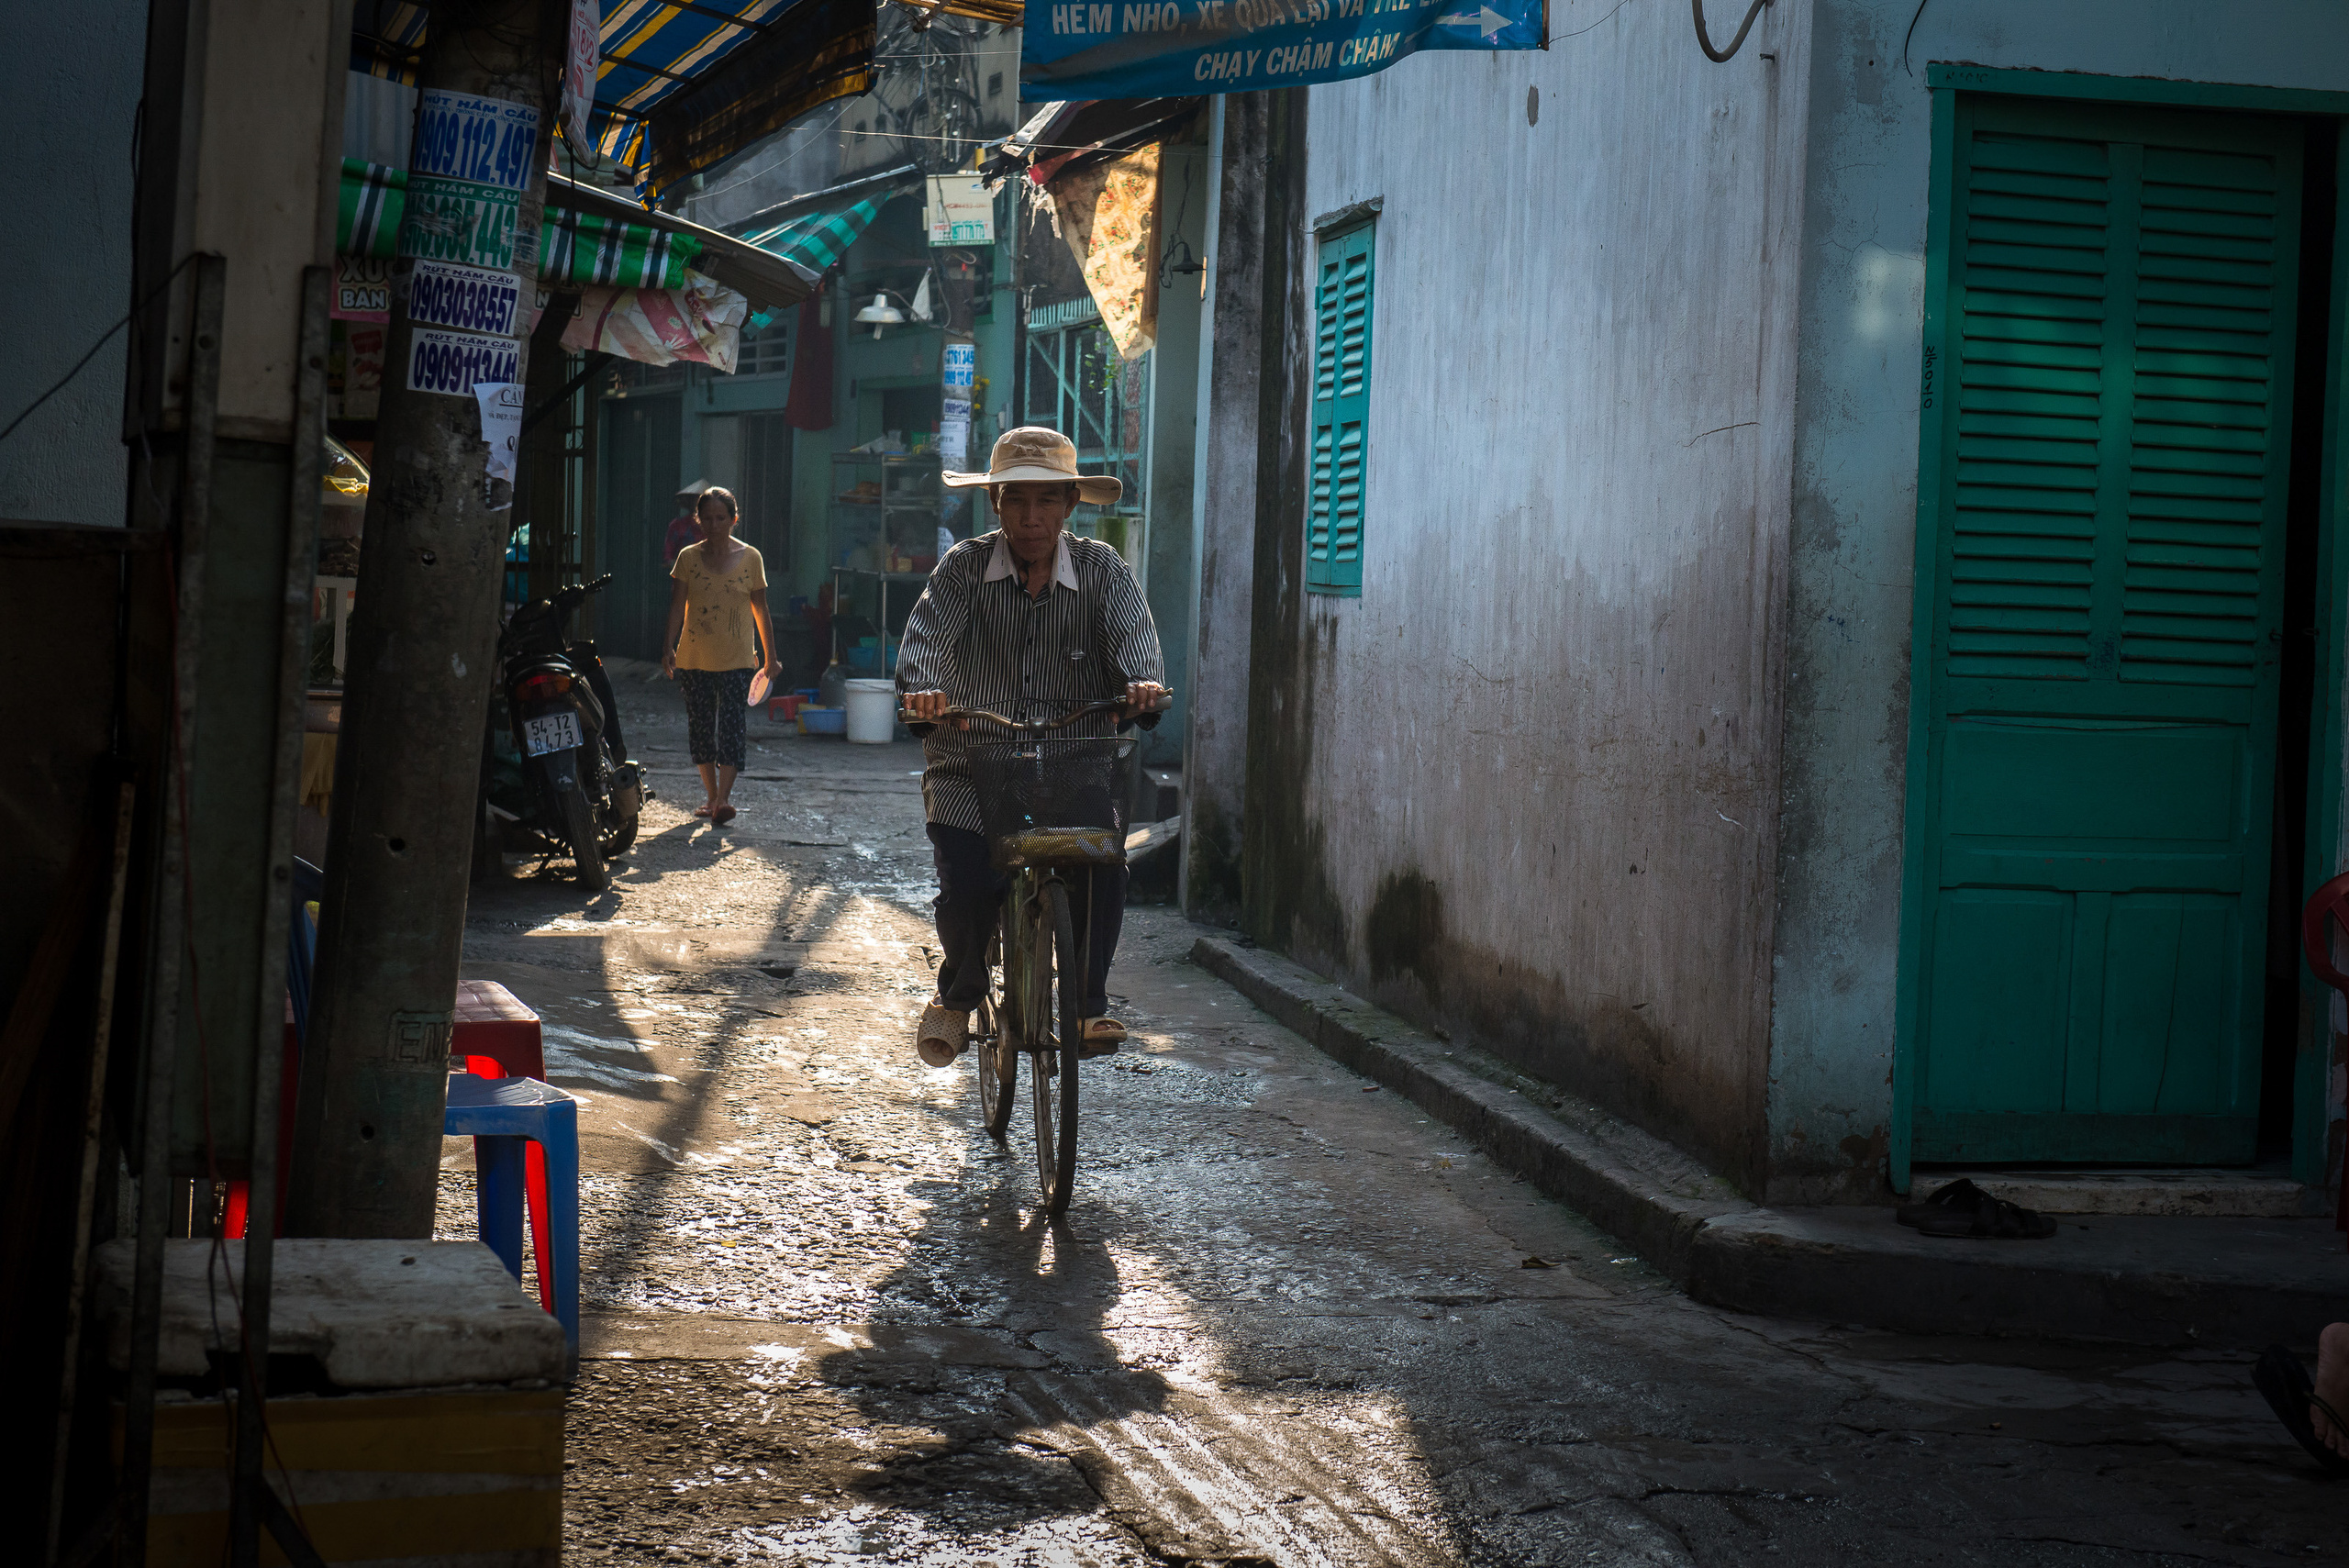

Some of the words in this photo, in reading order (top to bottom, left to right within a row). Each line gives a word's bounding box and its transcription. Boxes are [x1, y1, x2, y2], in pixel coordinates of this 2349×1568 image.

[1194, 50, 1262, 84] CHẠY
[1266, 37, 1334, 77] CHẬM
[1338, 28, 1401, 68] CHẬM
[415, 108, 536, 189] 0909.112.497
[410, 272, 518, 335] 0903038557
[530, 715, 571, 736] 54-T2
[534, 729, 573, 752] 8473
